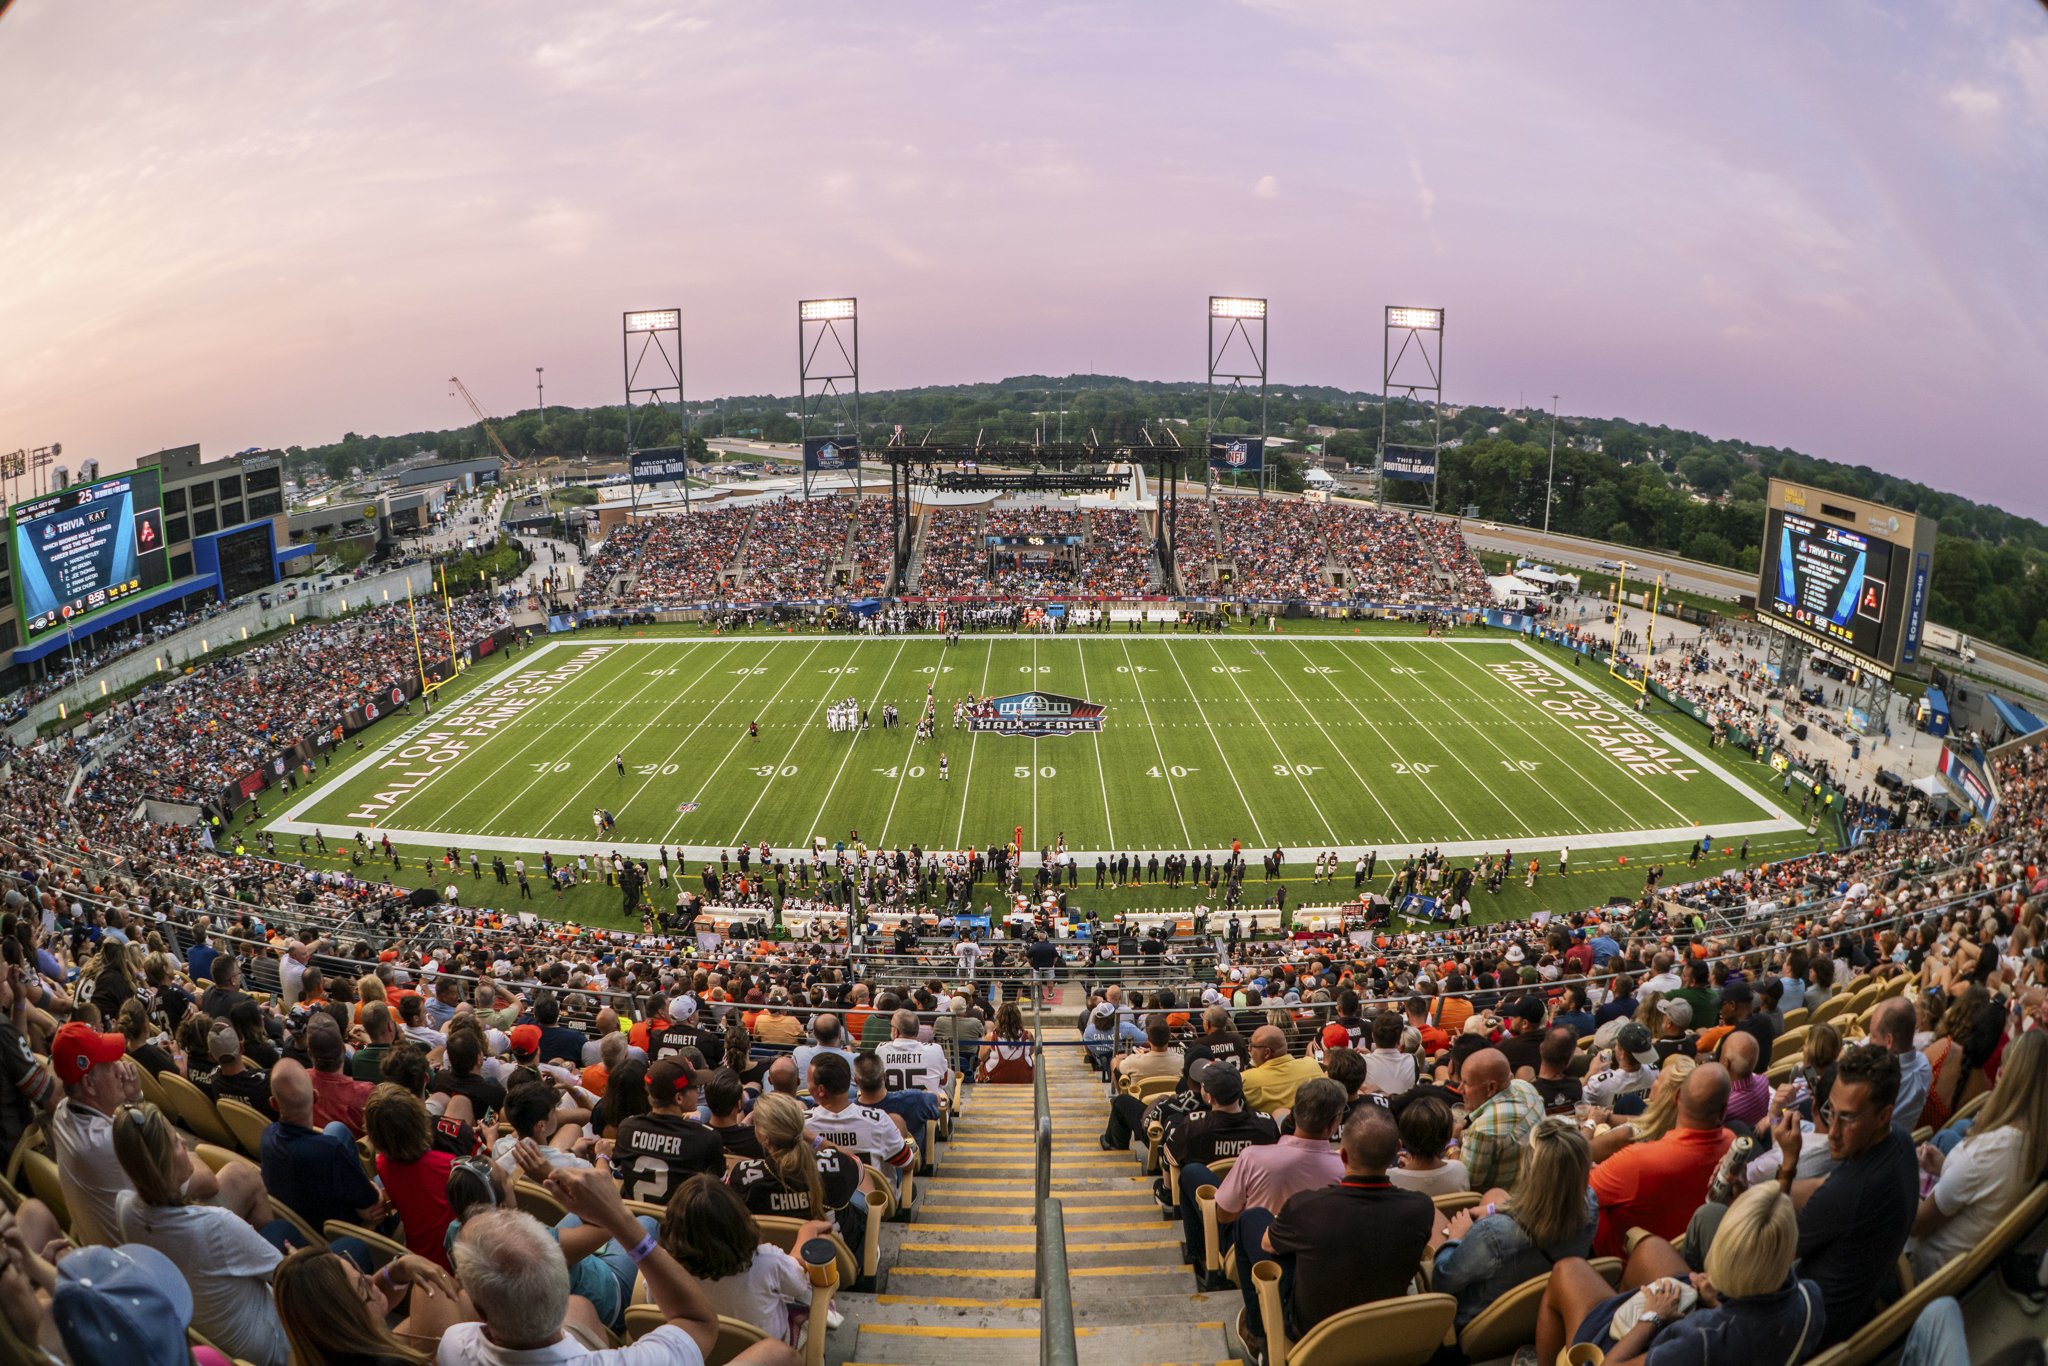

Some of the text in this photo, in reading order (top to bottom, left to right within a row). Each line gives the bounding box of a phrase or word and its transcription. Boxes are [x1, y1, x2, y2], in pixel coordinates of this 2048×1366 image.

[1228, 452, 1244, 462] NFL
[634, 462, 683, 477] CANTON, OHIO
[1383, 461, 1435, 475] FOOTBALL HEAVEN
[79, 489, 92, 505] 25
[57, 517, 85, 533] TRIVIA
[88, 511, 106, 522] KAY
[78, 531, 90, 540] HALL
[1826, 528, 1838, 542] 25
[1808, 544, 1844, 562] TRIVIA KAY
[120, 583, 127, 592] 10
[1915, 575, 1923, 606] STAY
[76, 600, 82, 609] 0
[88, 590, 105, 605] 9:56
[48, 611, 54, 620] 0
[1908, 611, 1919, 642] KNOW
[1757, 613, 1773, 626] TOM
[1773, 618, 1802, 638] BENSON
[1802, 632, 1821, 648] HALL
[1821, 641, 1834, 652] OF
[1833, 647, 1856, 664] FAME
[1855, 657, 1892, 681] STADIUM
[378, 670, 549, 769] TOM BENSON
[379, 744, 396, 752] IT
[395, 718, 438, 743] TAKES
[438, 702, 463, 715] ALL
[476, 682, 494, 691] US
[1485, 663, 1668, 776] HALL OF FAME
[1509, 660, 1701, 782] PRO FOOTBALL
[1594, 692, 1665, 734] END RACISM
[346, 646, 614, 819] HALL OF FAME STADIUM
[977, 720, 1029, 730] HALL
[1042, 721, 1097, 730] FAME
[568, 1021, 587, 1030] CHUBB
[663, 1034, 697, 1046] GARRETT
[886, 1053, 922, 1064] GARRETT
[885, 1068, 927, 1091] 95
[631, 1131, 681, 1155] COOPER
[633, 1155, 669, 1202] 2
[770, 1192, 809, 1211] CHUB
